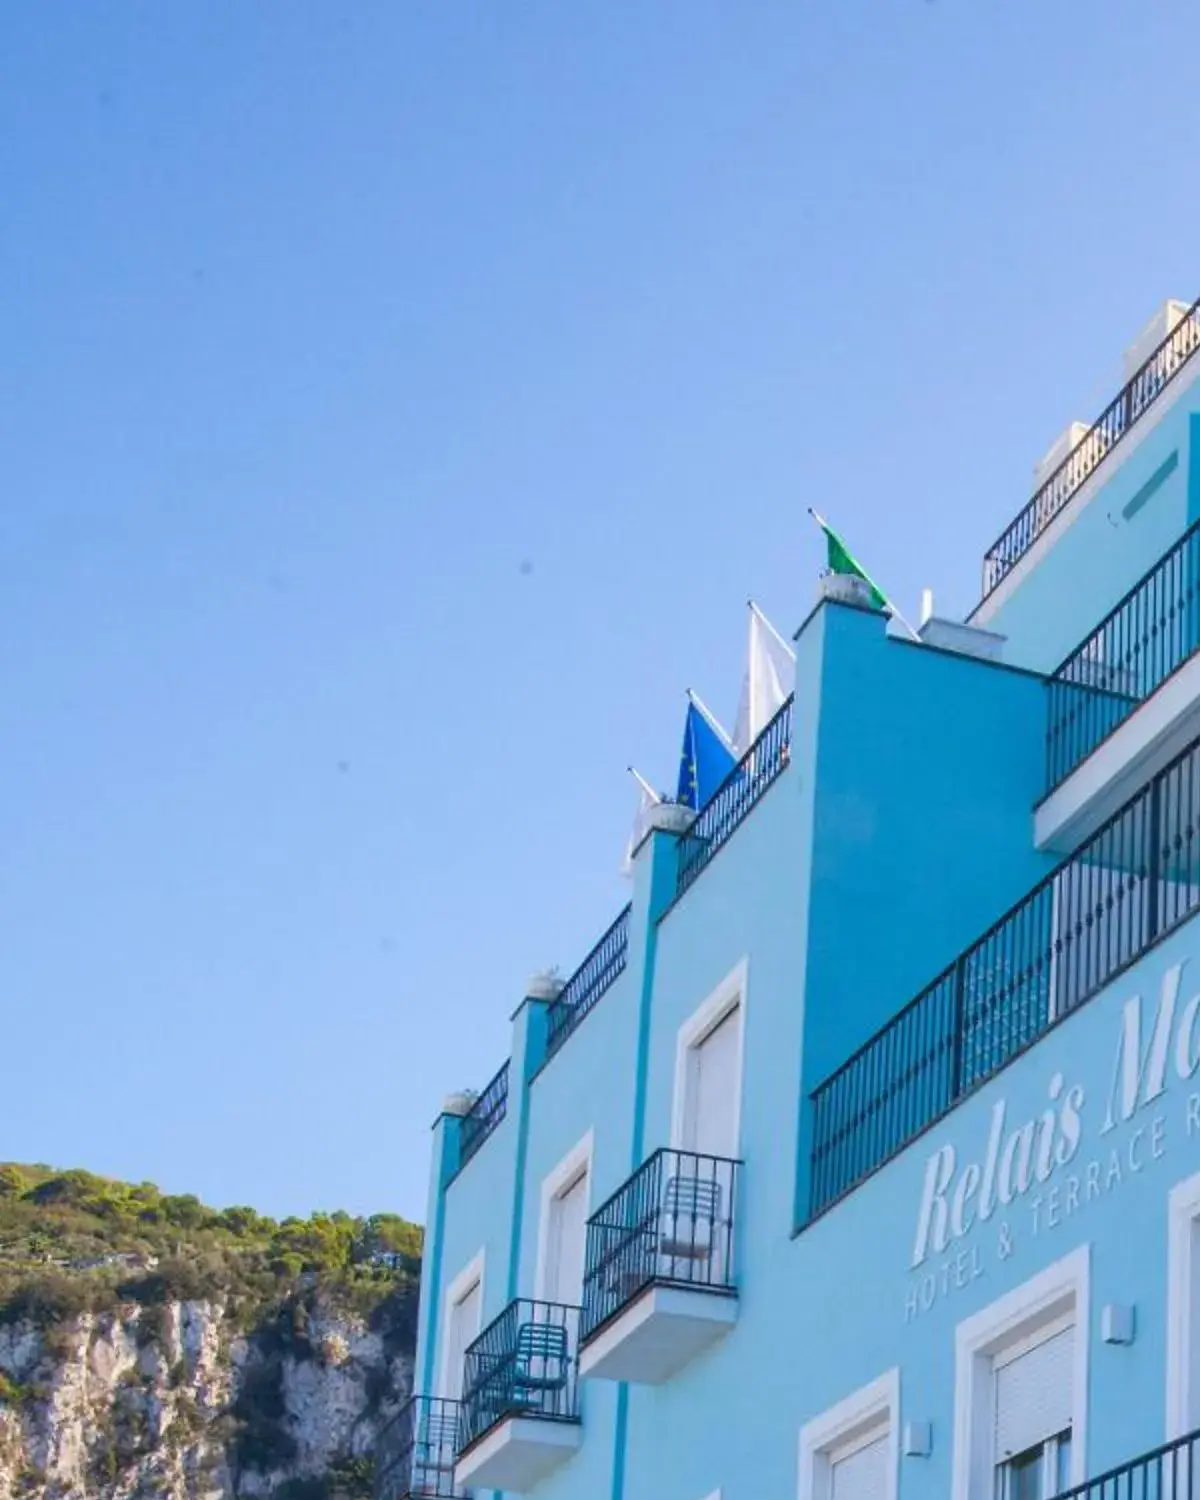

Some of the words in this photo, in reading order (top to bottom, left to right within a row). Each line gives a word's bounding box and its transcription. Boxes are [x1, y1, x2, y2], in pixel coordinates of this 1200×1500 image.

[904, 1247, 983, 1322] HOTEL
[998, 1221, 1011, 1261] &
[1031, 1116, 1166, 1235] TERRACE
[911, 1073, 1083, 1270] Relais
